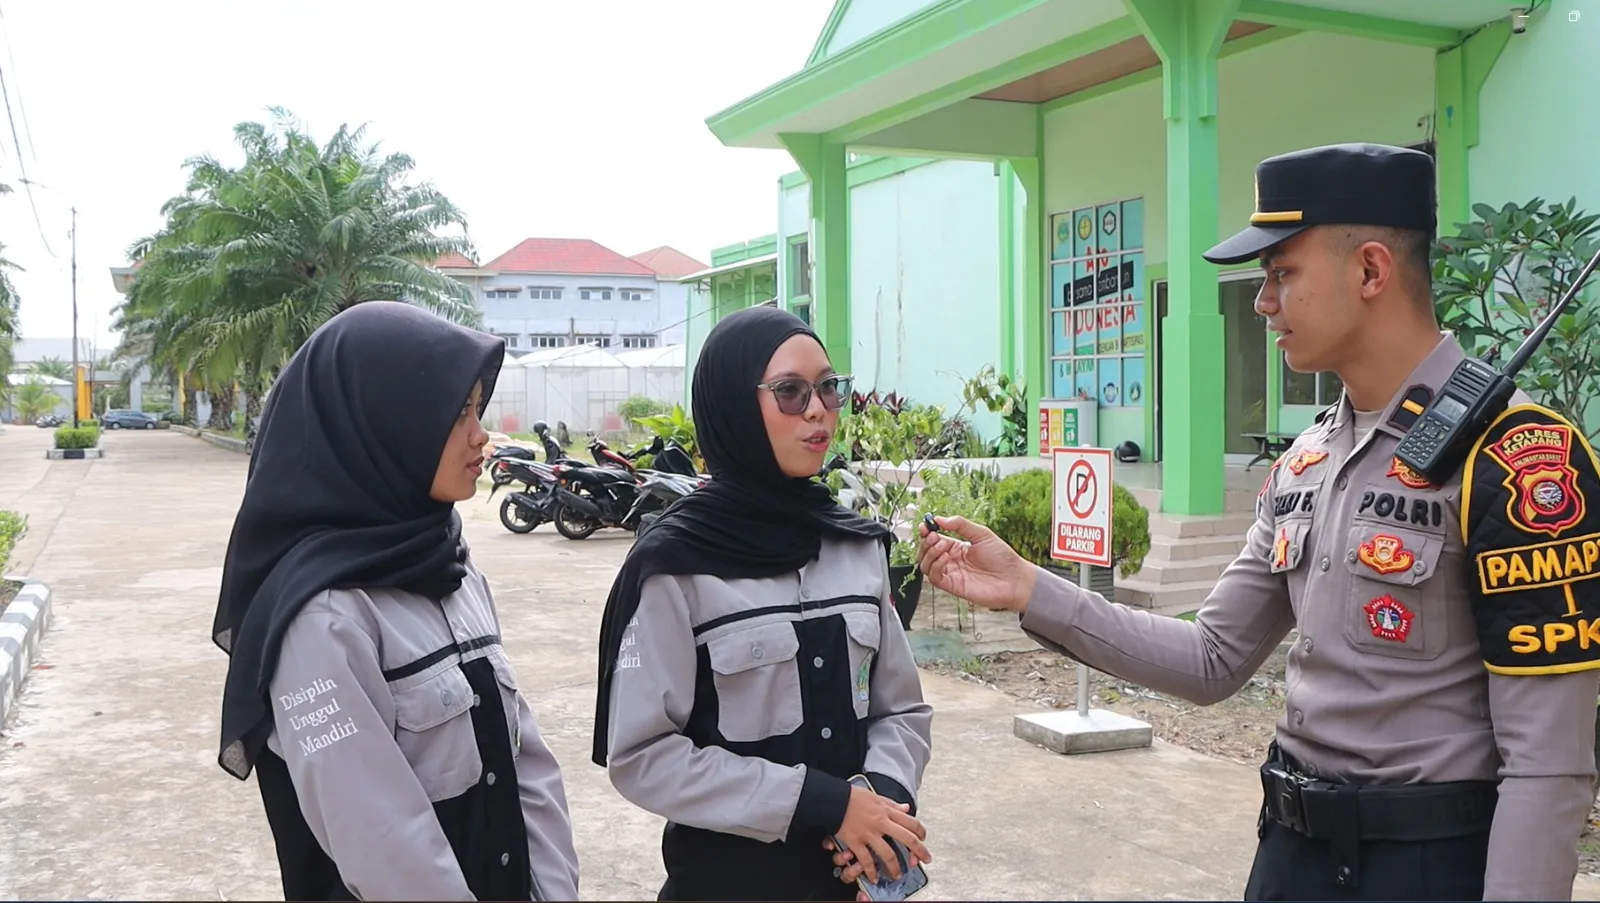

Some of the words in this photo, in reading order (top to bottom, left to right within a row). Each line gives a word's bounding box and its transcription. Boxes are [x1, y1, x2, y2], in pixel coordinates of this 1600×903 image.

[1502, 429, 1561, 449] POLRES
[1504, 437, 1563, 456] KETAPANG
[1358, 491, 1442, 527] POLRI
[1060, 524, 1102, 541] DILARANG
[1065, 538, 1096, 553] PARKIR
[279, 678, 338, 711] Disiplin
[289, 697, 341, 731] Unggul
[298, 716, 359, 757] Mandiri
